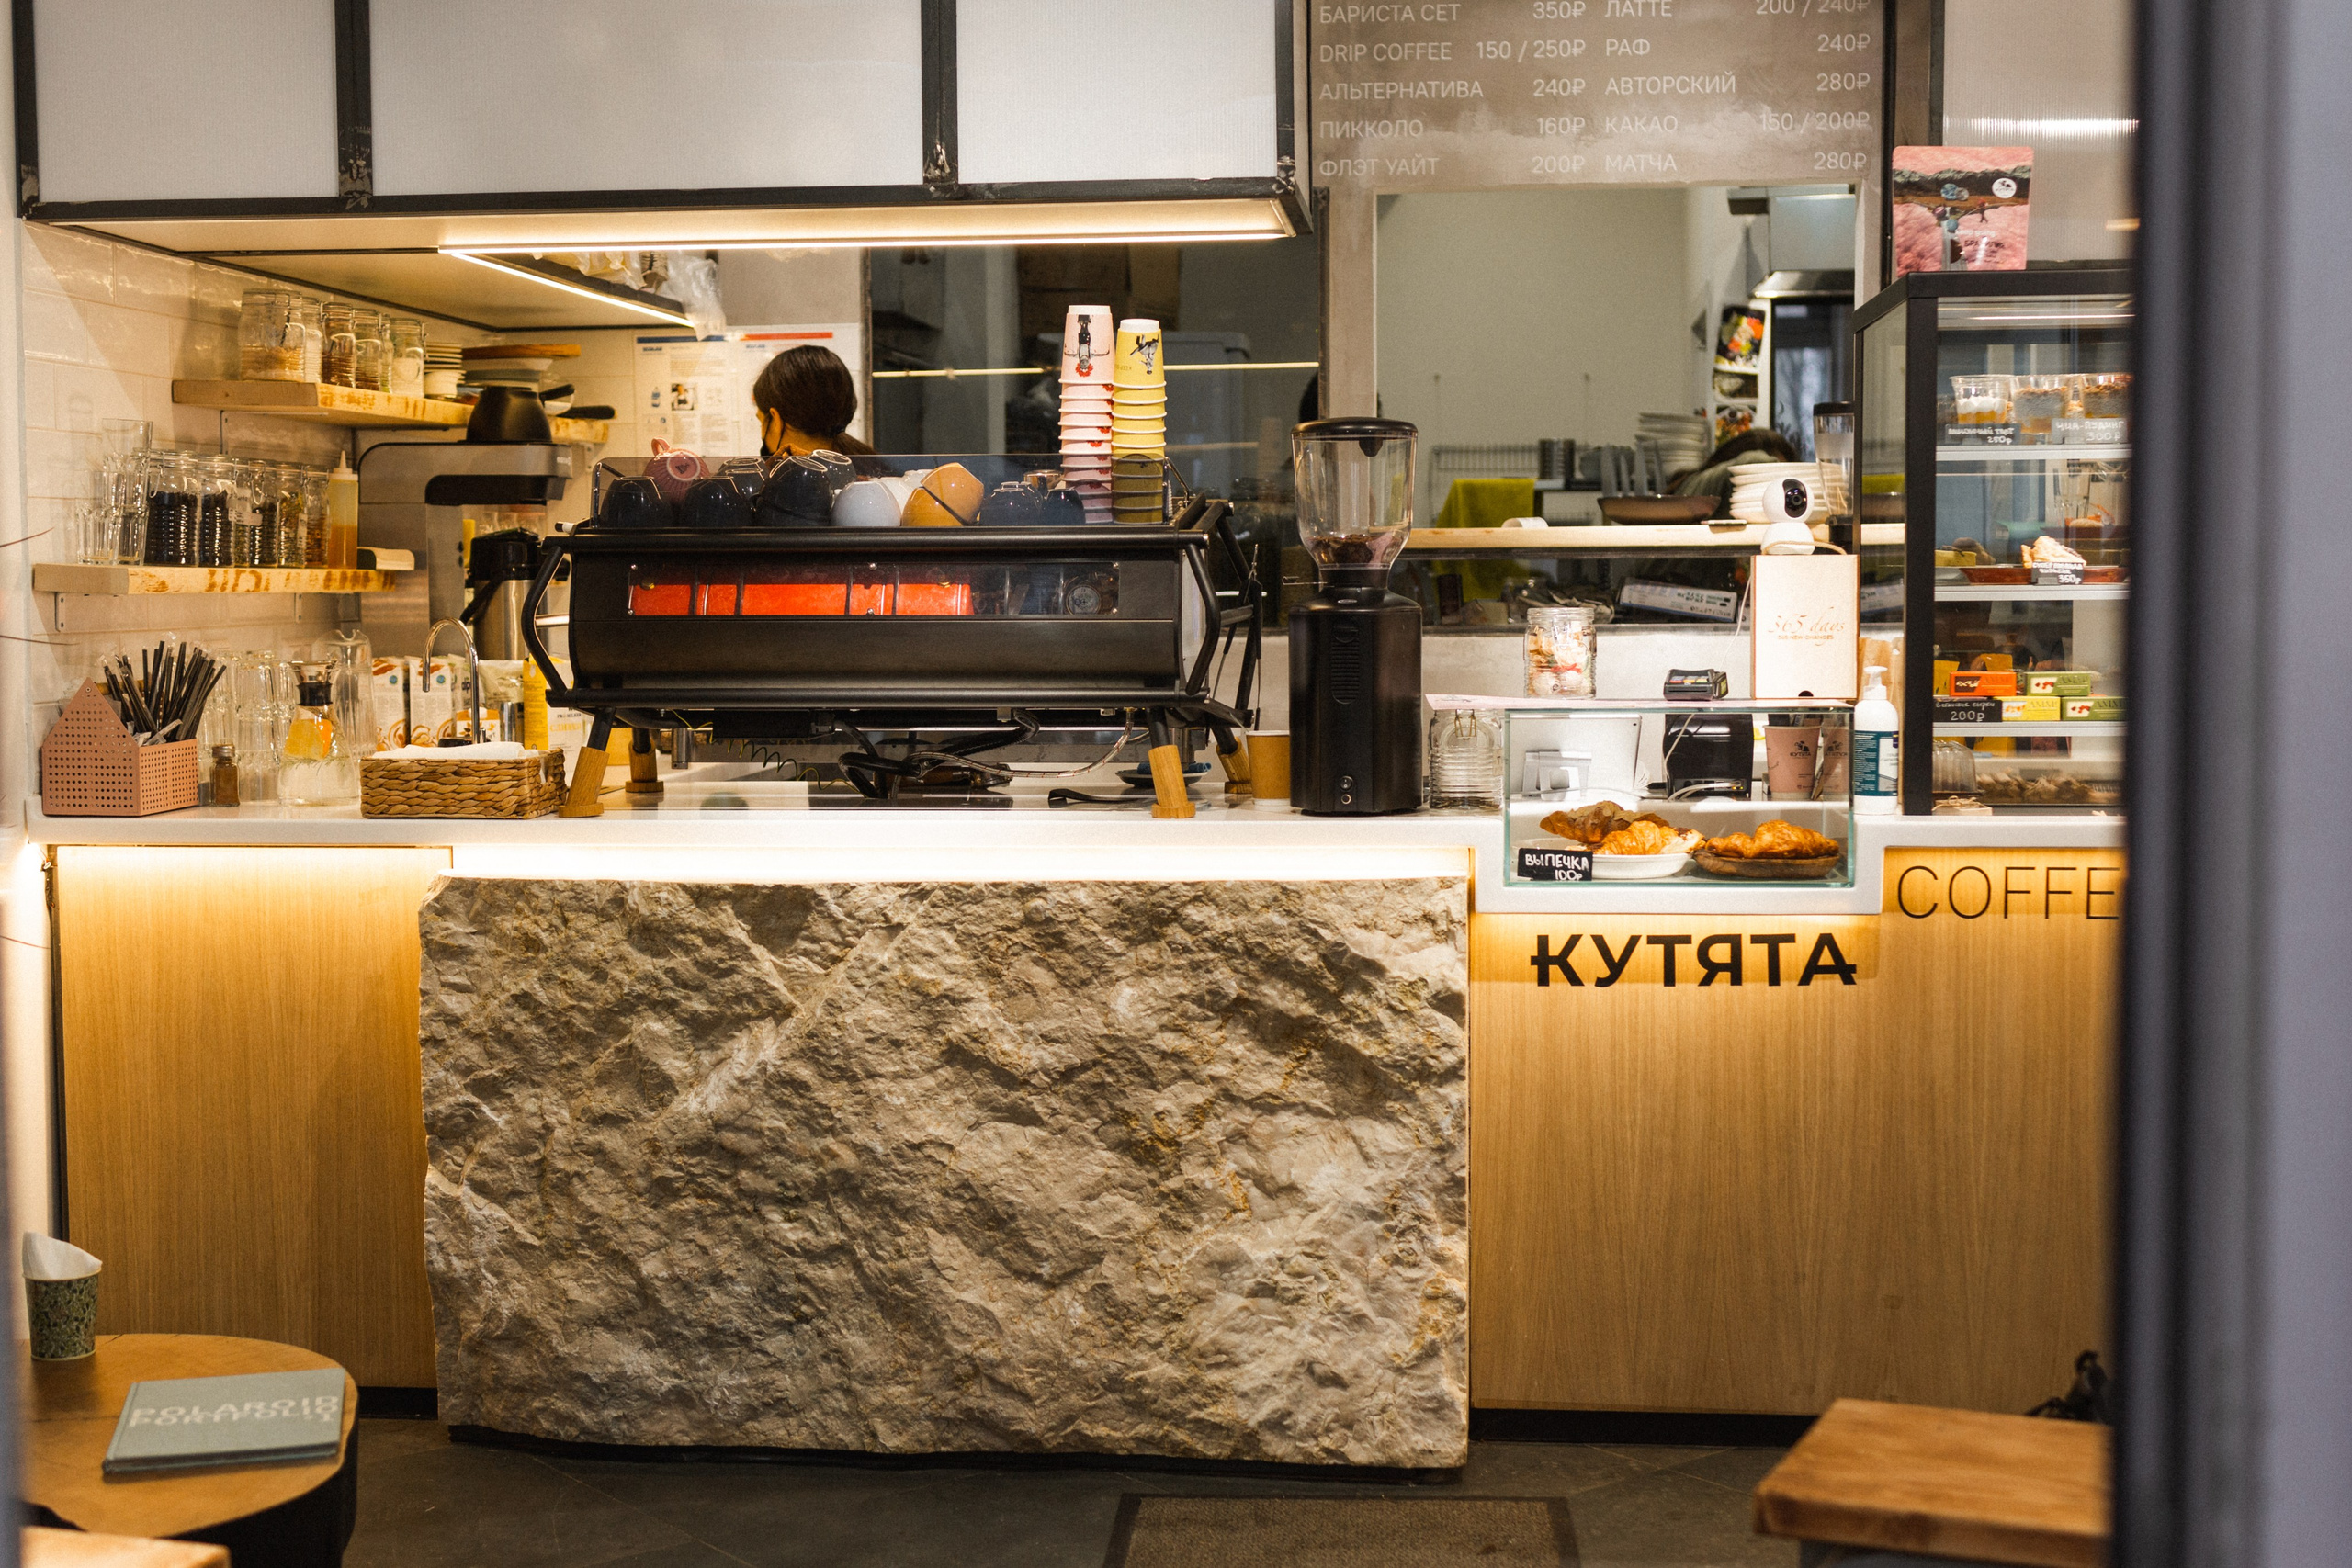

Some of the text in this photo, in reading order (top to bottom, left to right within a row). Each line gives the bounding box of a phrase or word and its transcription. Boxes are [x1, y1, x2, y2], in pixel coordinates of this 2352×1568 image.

[1319, 1, 1587, 24] БАРИСТА СЕТ 350₽
[1605, 0, 1672, 17] ЛАТТЕ
[1319, 39, 1586, 62] DRIP COFFEE 150 / 250₽
[1606, 33, 1871, 56] РАФ 240₽
[1319, 78, 1586, 100] АЛЬТЕРНАТИВА 240₽
[1605, 71, 1871, 95] АВТОРСКИЙ 280₽
[1319, 116, 1586, 138] ПИККОЛО 160₽
[1606, 115, 1679, 134] КАКАО
[1760, 112, 1793, 130] 150
[1815, 111, 1871, 130] 200₽
[1319, 152, 1586, 176] ФЛЭТ УАЙТ 200₽
[1606, 152, 1867, 173] МАТЧА 280₽
[2055, 421, 2124, 431] ЧИА-ПУДИНГ
[1768, 606, 1845, 646] 365 days
[1525, 853, 1589, 872] ВЫПЕЧКА
[1531, 932, 1857, 988] КУТЯТА
